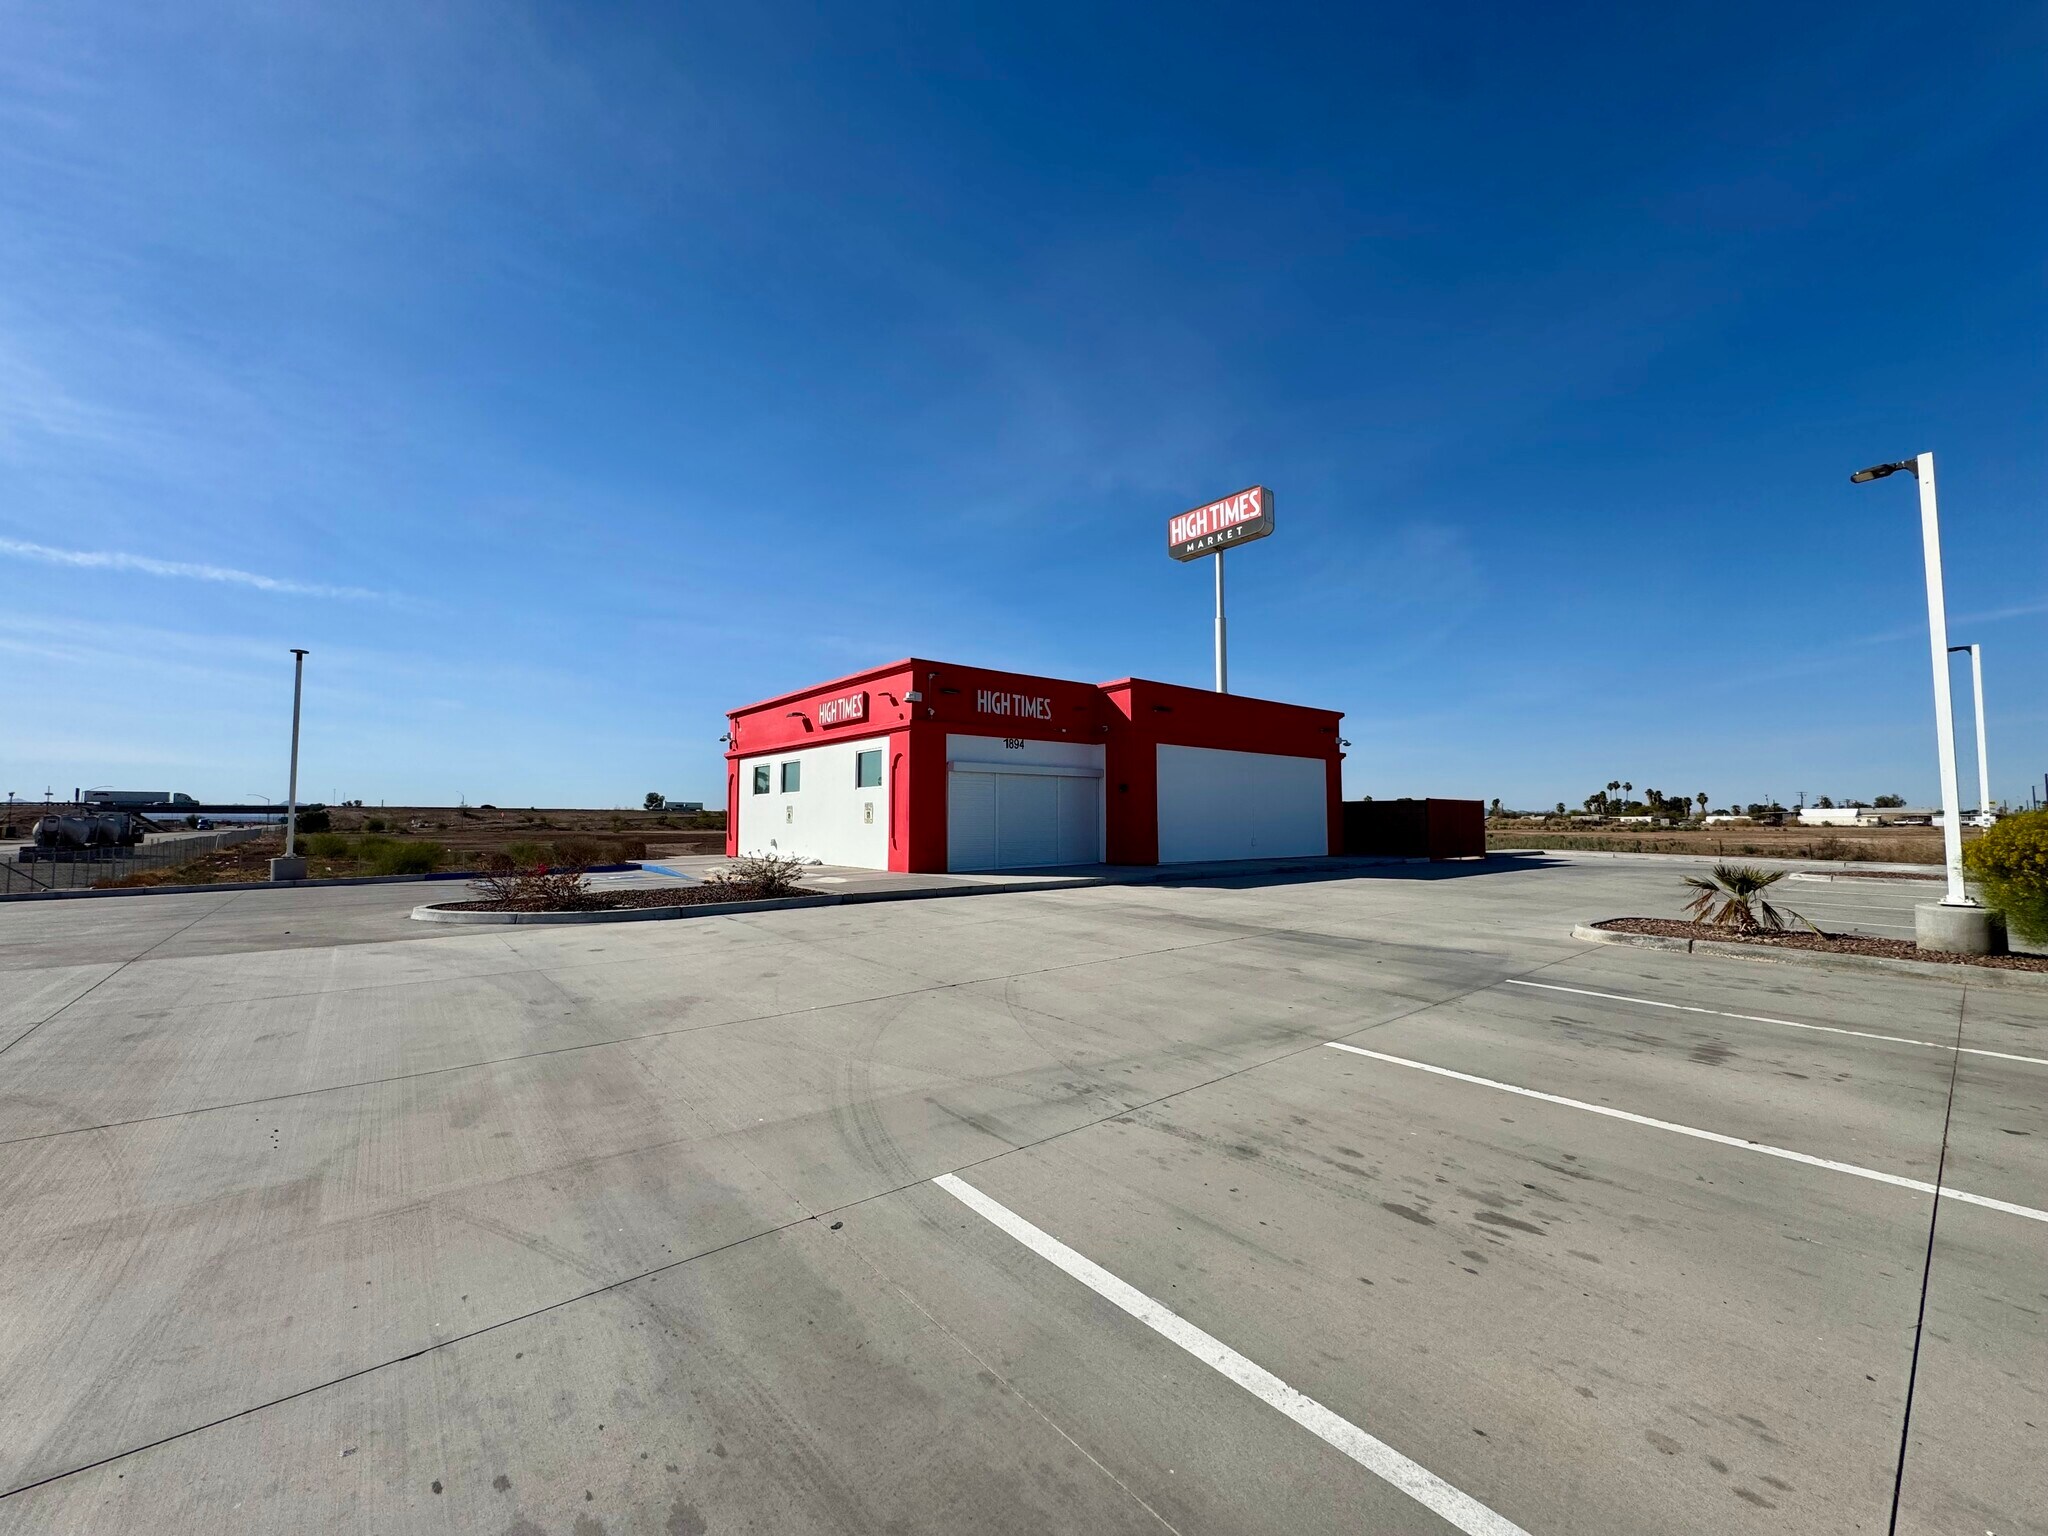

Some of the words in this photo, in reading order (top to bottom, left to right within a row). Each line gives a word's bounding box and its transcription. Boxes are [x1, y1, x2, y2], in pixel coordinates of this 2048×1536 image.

[1171, 507, 1208, 544] HIGH
[1209, 490, 1260, 530] TIMES
[1186, 526, 1243, 552] MARKET
[818, 700, 837, 725] HIGH
[837, 693, 863, 720] TIMES
[977, 689, 1011, 716] HIGH
[1012, 693, 1052, 720] TIMES
[1003, 738, 1025, 750] 1894
